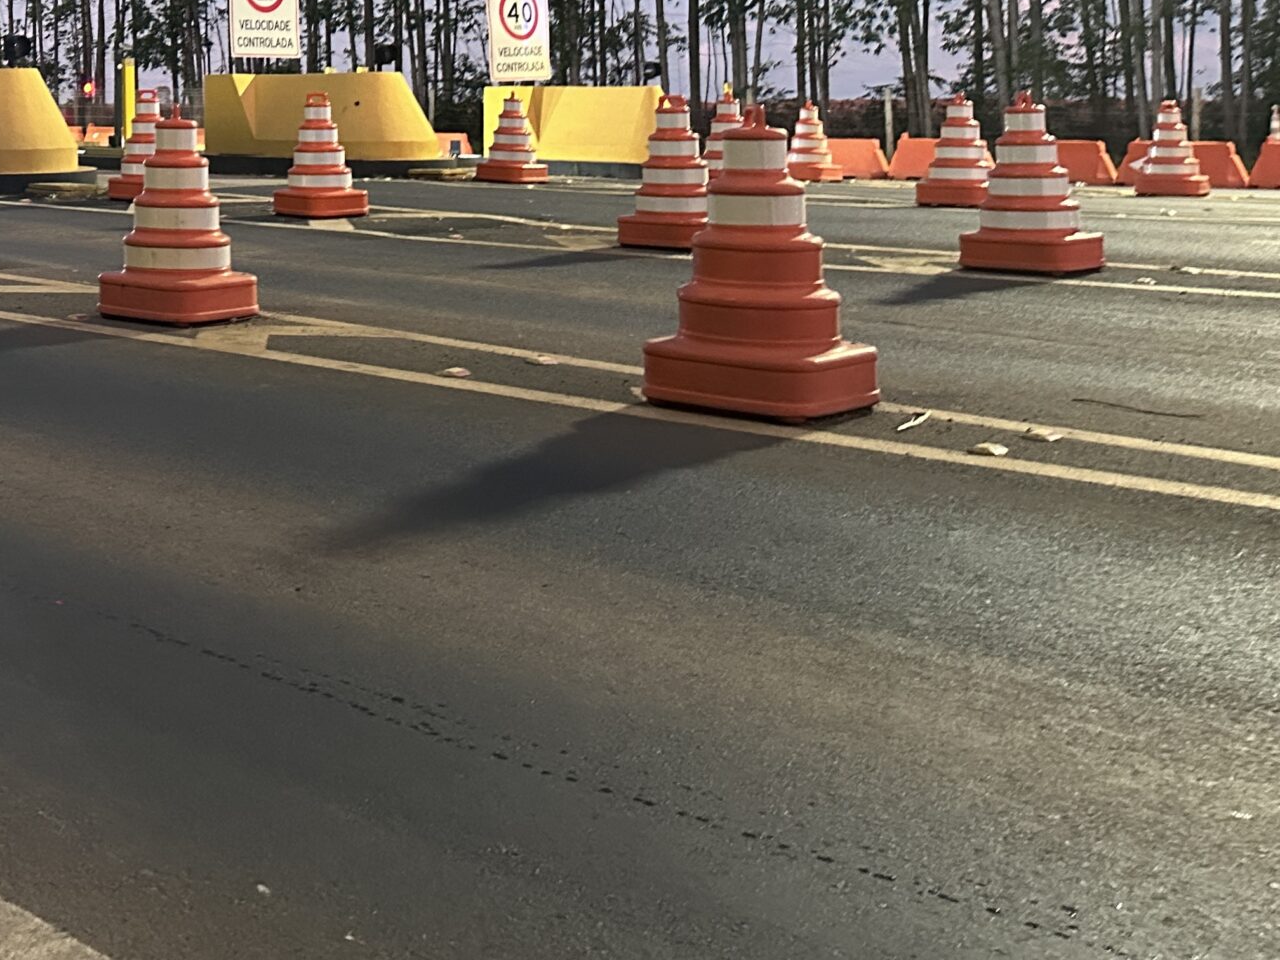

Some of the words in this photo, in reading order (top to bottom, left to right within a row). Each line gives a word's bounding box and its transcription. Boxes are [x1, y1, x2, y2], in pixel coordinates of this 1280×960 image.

[507, 2, 532, 23] 40
[239, 20, 292, 32] VELOCIDADE
[237, 36, 294, 49] CONTROLADA
